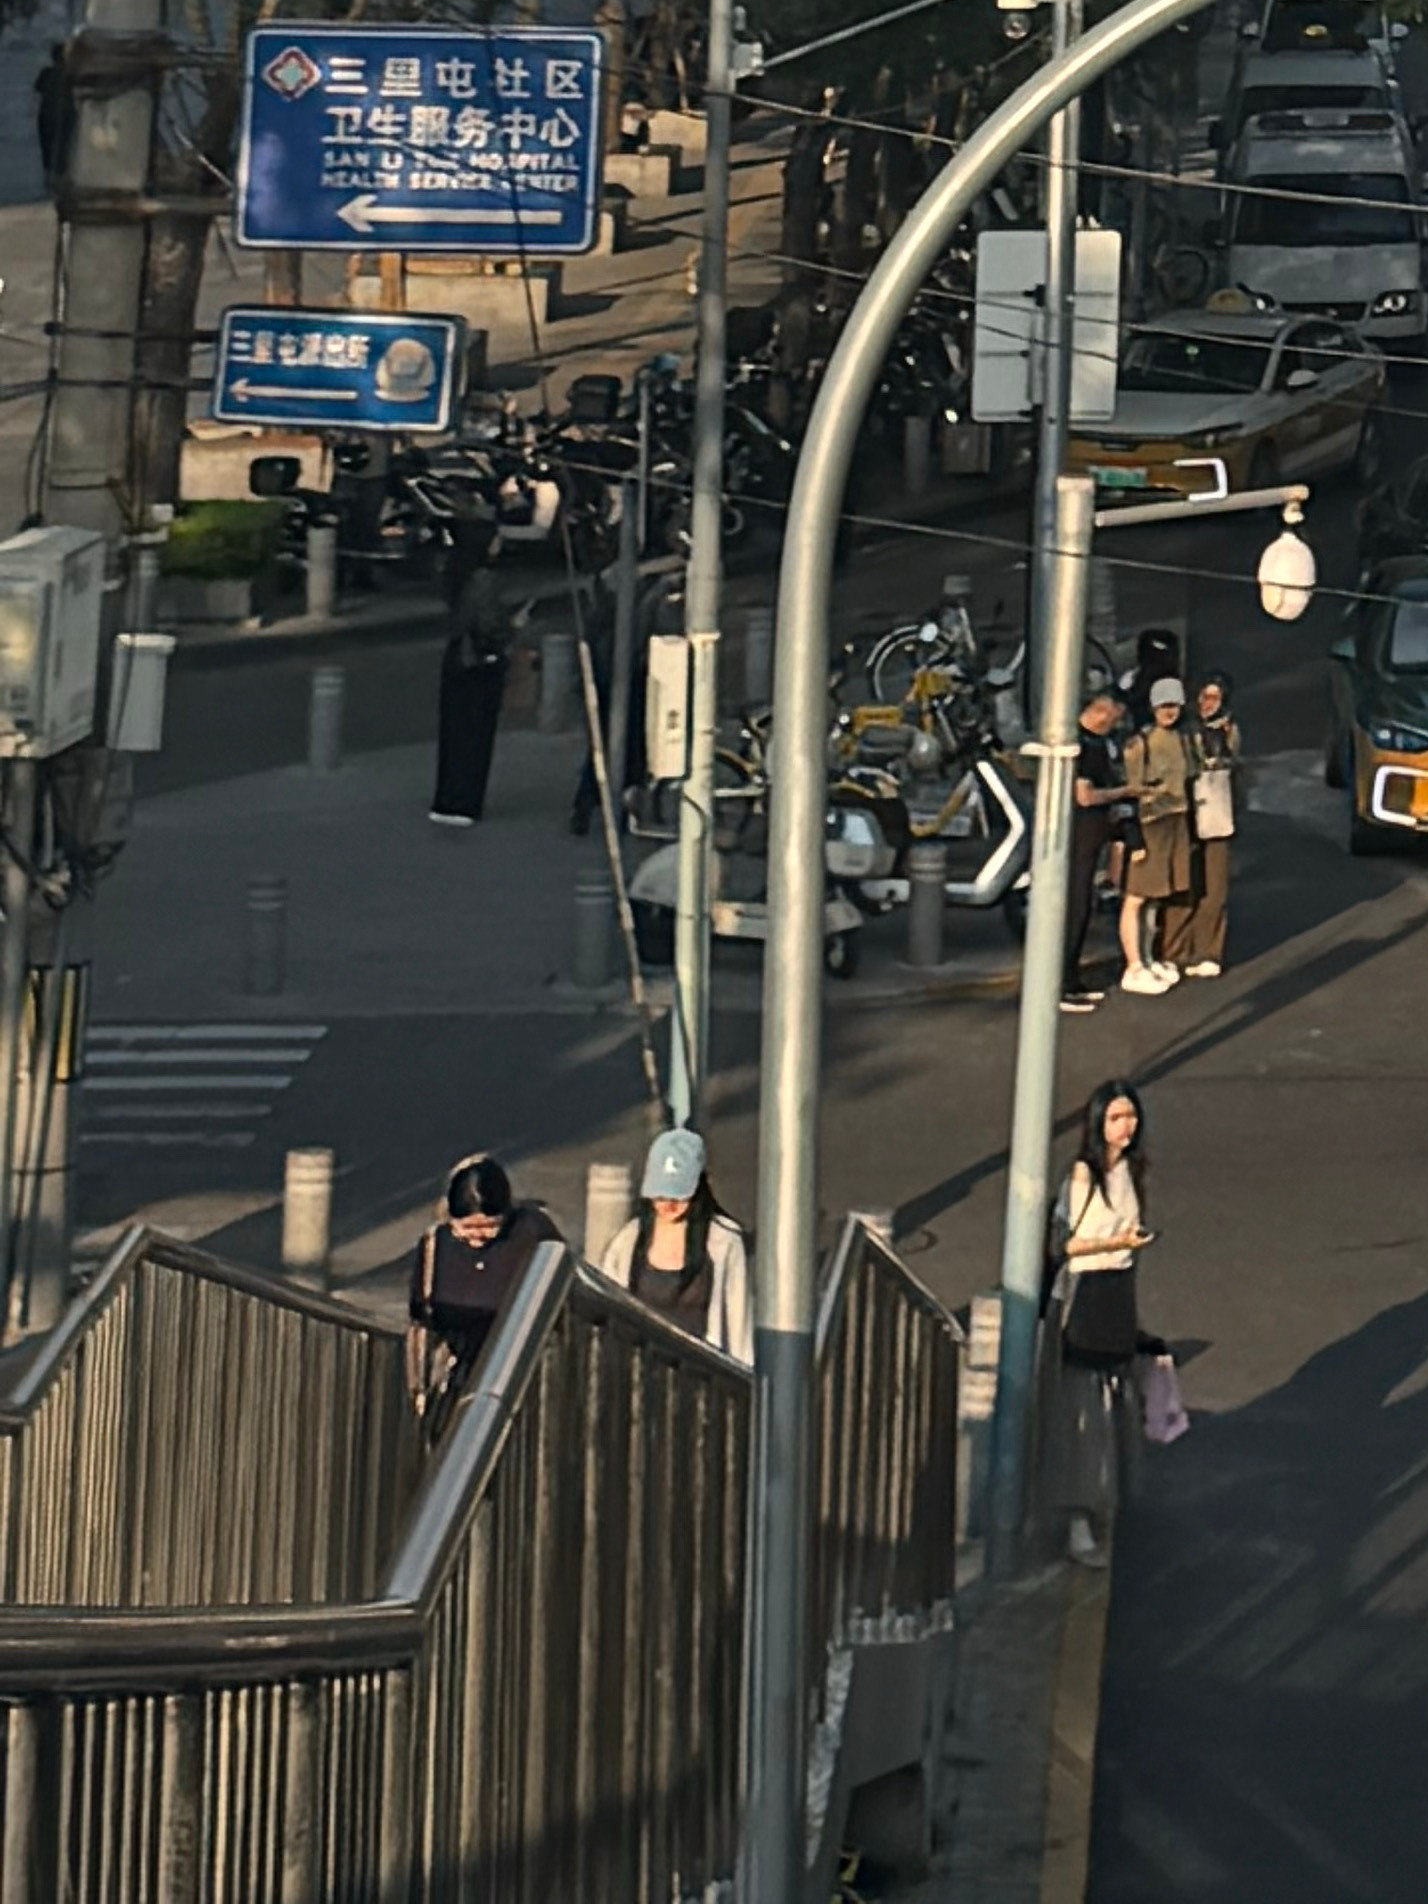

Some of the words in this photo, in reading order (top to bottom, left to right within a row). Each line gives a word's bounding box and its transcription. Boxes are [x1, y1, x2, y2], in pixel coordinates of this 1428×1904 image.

[323, 56, 584, 100] 三里屯社区
[321, 104, 581, 150] 卫生服务中心
